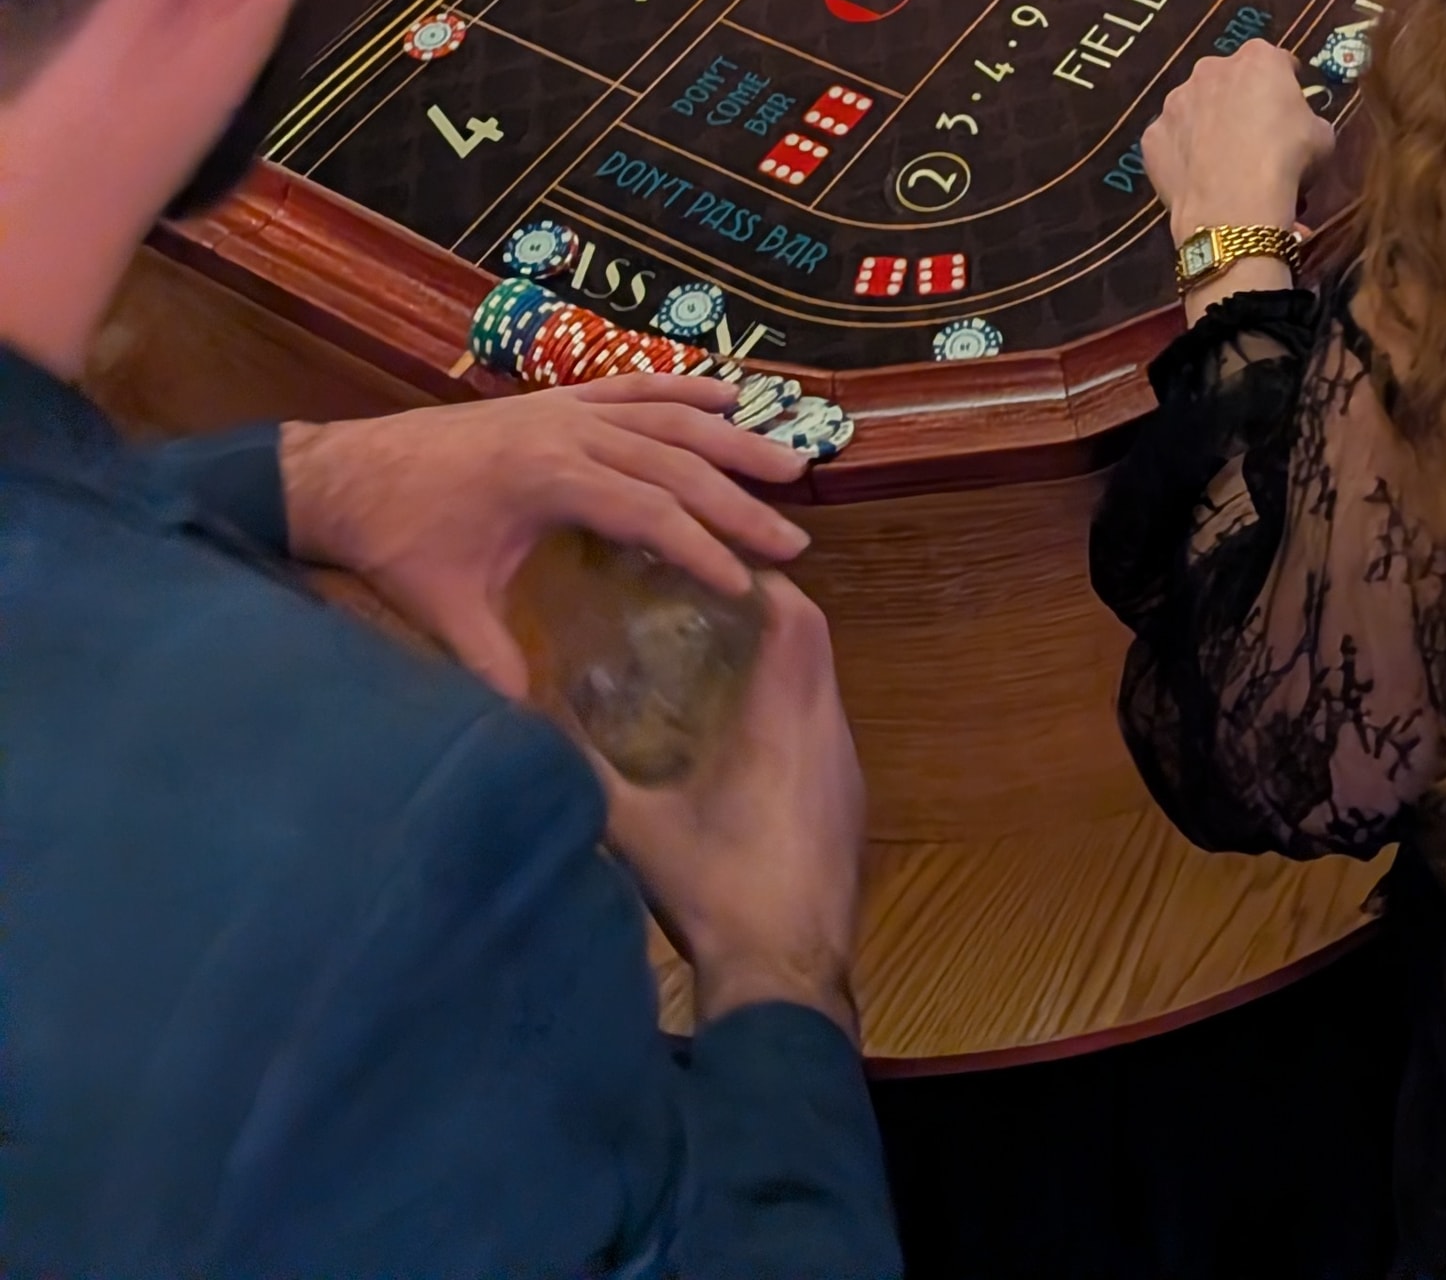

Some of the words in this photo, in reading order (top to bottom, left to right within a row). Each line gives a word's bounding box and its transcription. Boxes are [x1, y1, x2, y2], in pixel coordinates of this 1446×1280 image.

[706, 72, 771, 126] COME
[743, 93, 797, 136] BAR
[907, 167, 957, 194] 2
[935, 111, 979, 136] 3
[973, 59, 1015, 83] 4
[1010, 4, 1049, 28] 9
[426, 103, 504, 159] 4
[595, 150, 694, 209] DON'T
[684, 191, 763, 242] PASS
[754, 224, 830, 275] BAR
